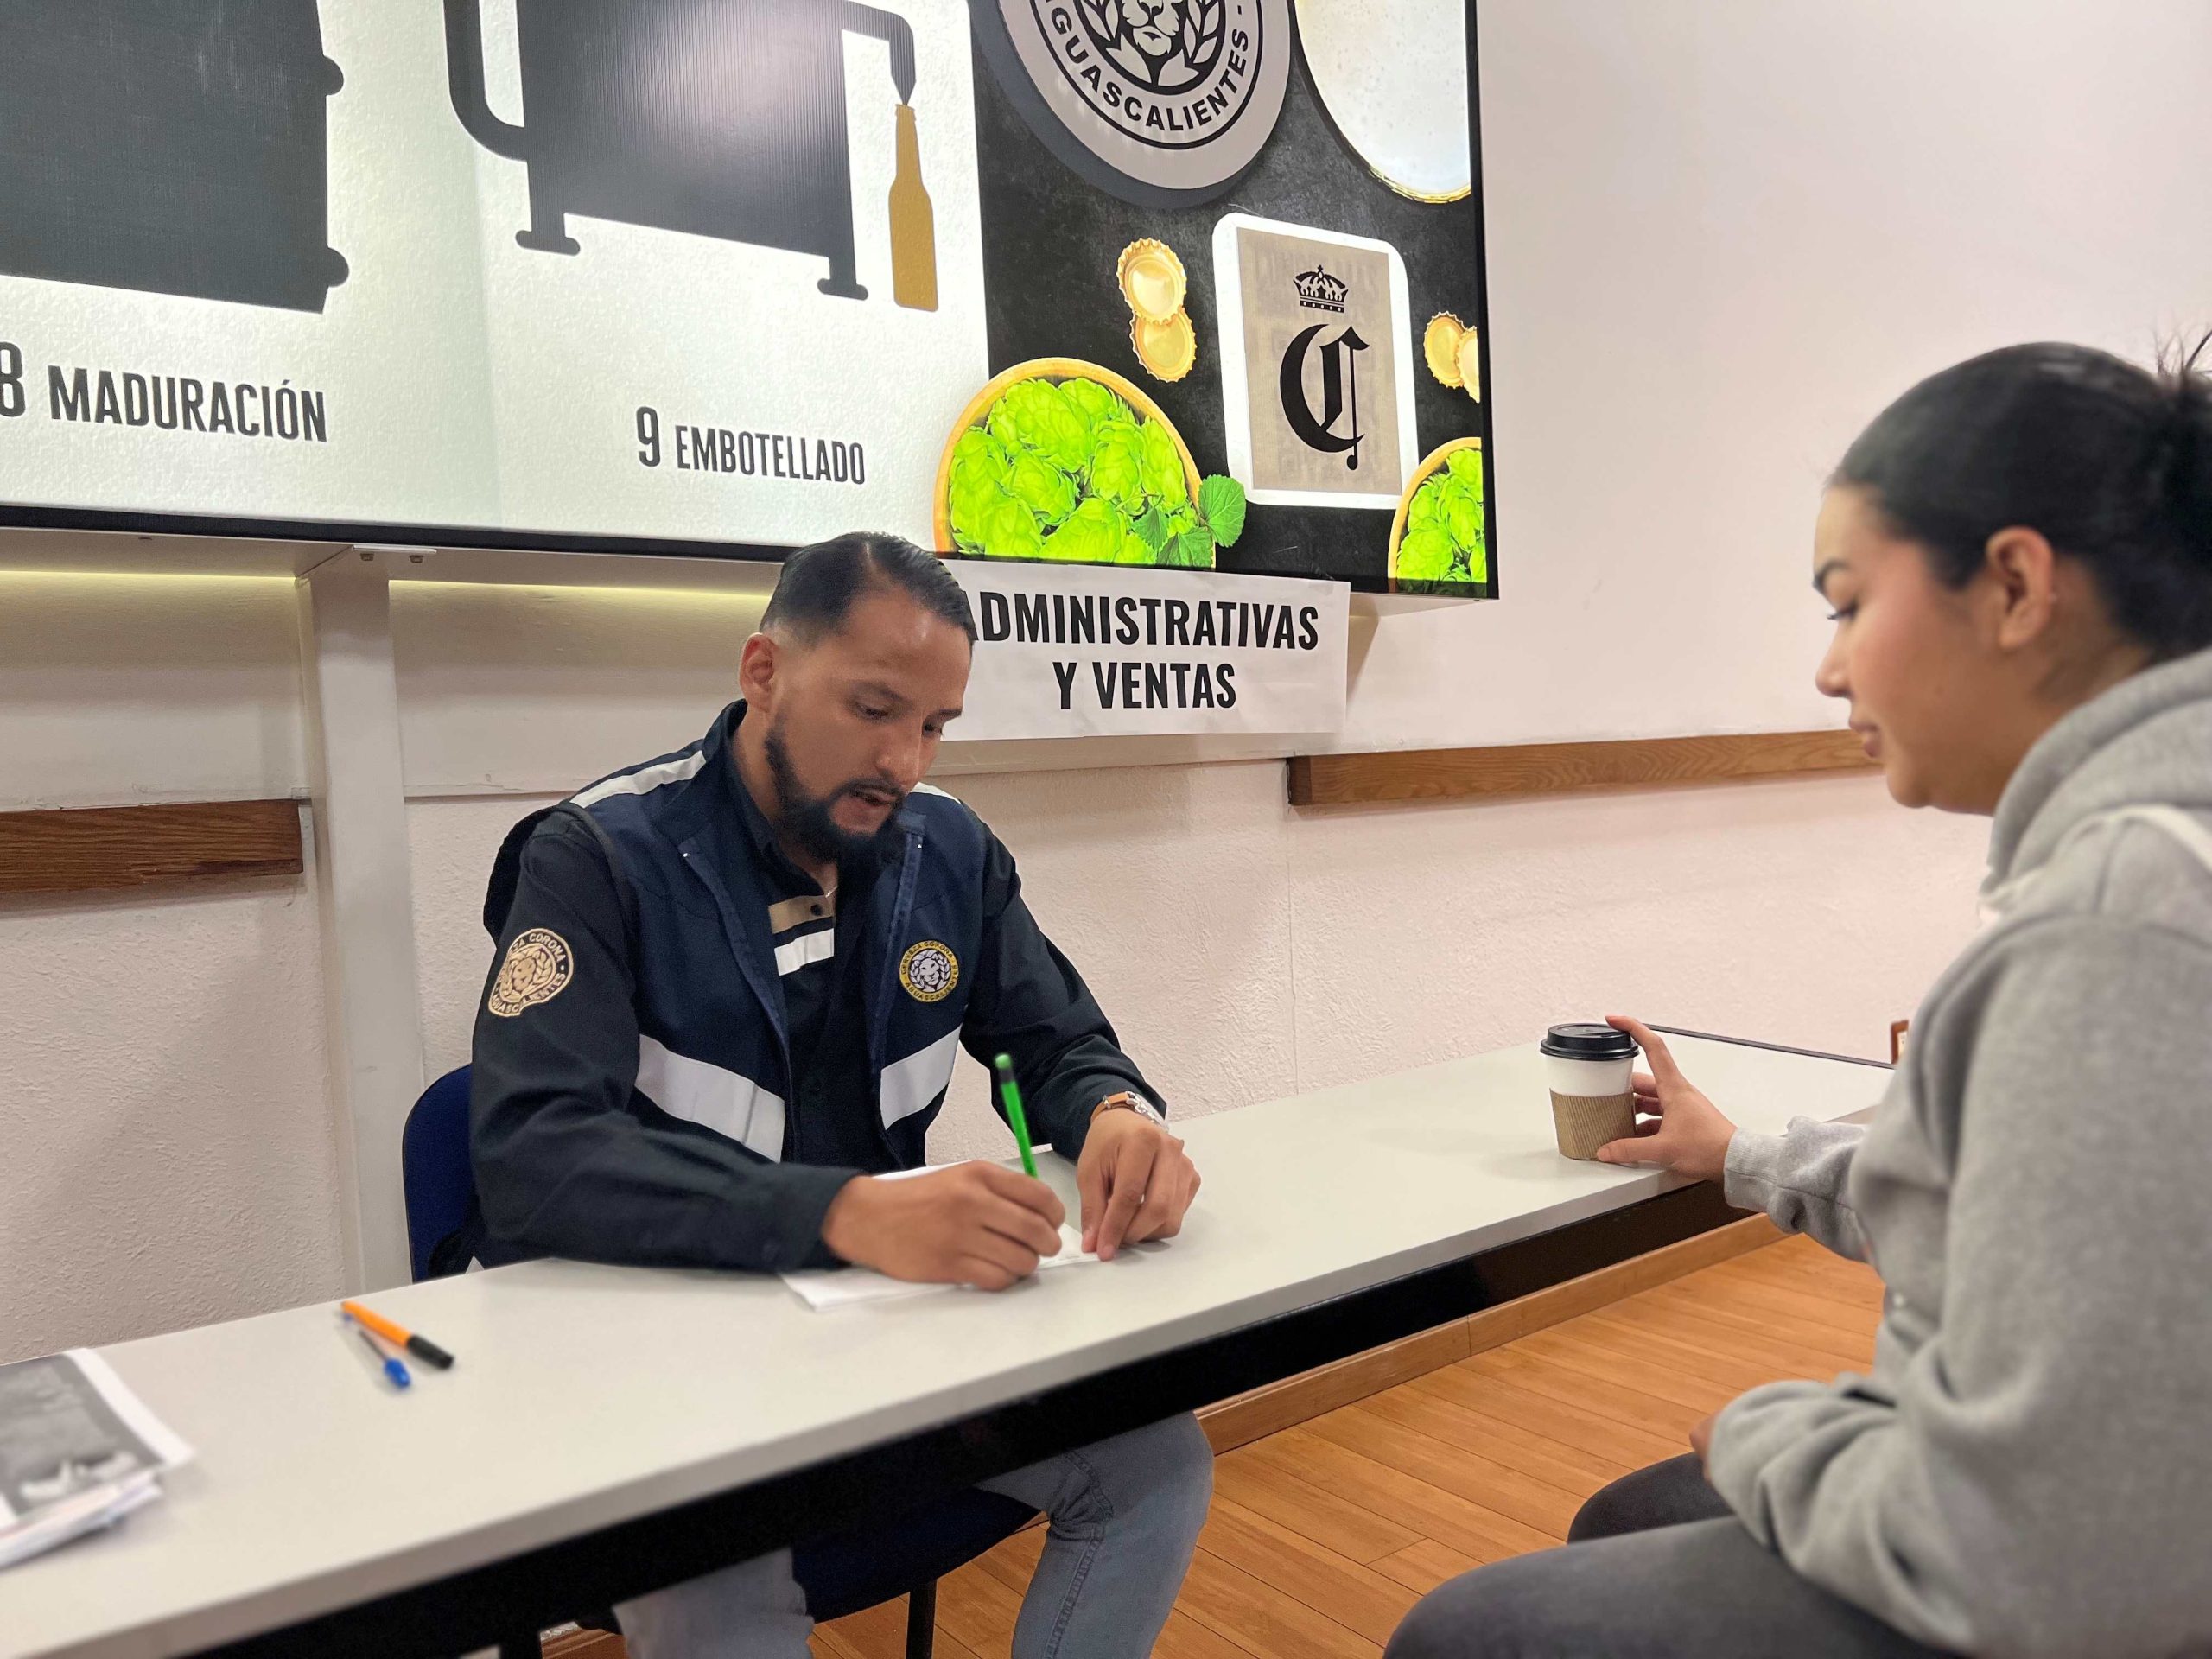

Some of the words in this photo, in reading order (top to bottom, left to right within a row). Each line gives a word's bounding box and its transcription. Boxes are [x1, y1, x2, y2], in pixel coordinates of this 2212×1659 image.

[1046, 0, 1249, 131] GUASCALIENTES
[0, 341, 26, 417] 8
[48, 365, 327, 442] MADURACIÓN
[636, 406, 661, 467] 9
[675, 424, 865, 485] EMBOTELLADO
[1052, 662, 1077, 709] Y
[1092, 662, 1236, 709] VENTAS
[529, 932, 567, 963] CORONA
[901, 944, 923, 975] CERVEZA
[924, 941, 953, 957] CORONA
